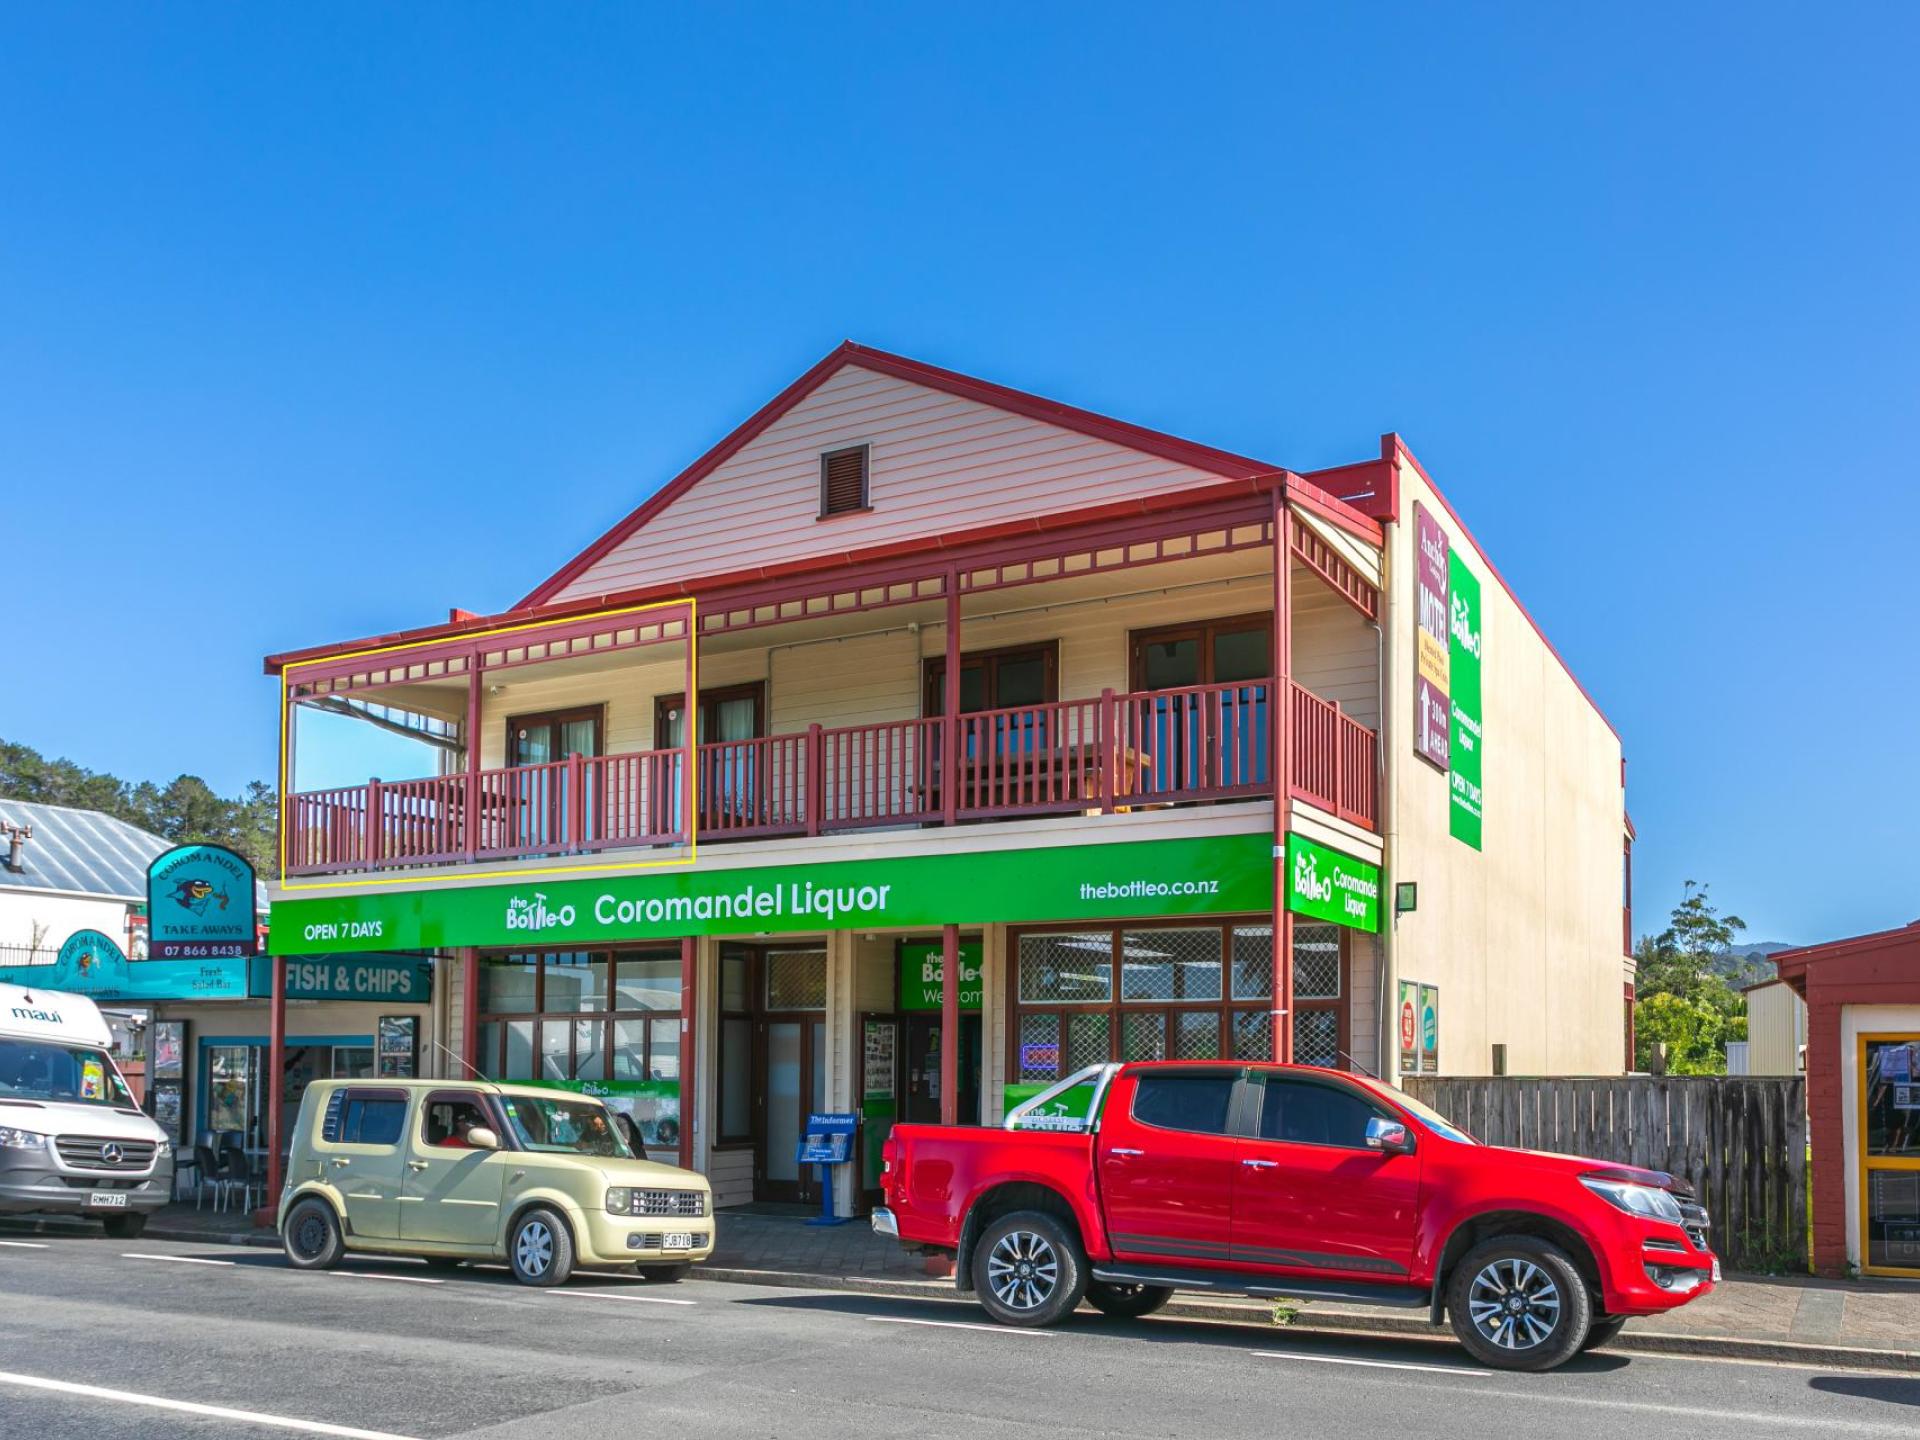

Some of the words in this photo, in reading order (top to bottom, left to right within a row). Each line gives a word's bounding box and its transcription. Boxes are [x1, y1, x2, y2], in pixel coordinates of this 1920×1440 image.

[1420, 582, 1448, 653] MOTEL
[1452, 770, 1466, 795] OPEN
[158, 853, 245, 881] COROMANDEL
[1080, 880, 1219, 900] thebottleo.co.nz
[510, 896, 527, 908] the
[594, 883, 782, 925] Coromandel
[791, 881, 891, 921] Liquor
[1345, 892, 1367, 918] Liquor
[163, 925, 199, 935] TAKE
[201, 924, 243, 935] AWAYS
[304, 924, 338, 941] OPEN
[341, 923, 349, 938] 7
[351, 920, 383, 938] DAYS
[164, 946, 179, 956] 07
[183, 946, 208, 956] 866
[211, 945, 242, 956] 8438
[926, 952, 945, 964] the
[285, 963, 330, 991] FISH
[334, 966, 350, 991] &
[354, 967, 412, 994] CHIPS
[12, 1008, 63, 1024] maui
[811, 1116, 822, 1124] The
[822, 1116, 854, 1125] Informer
